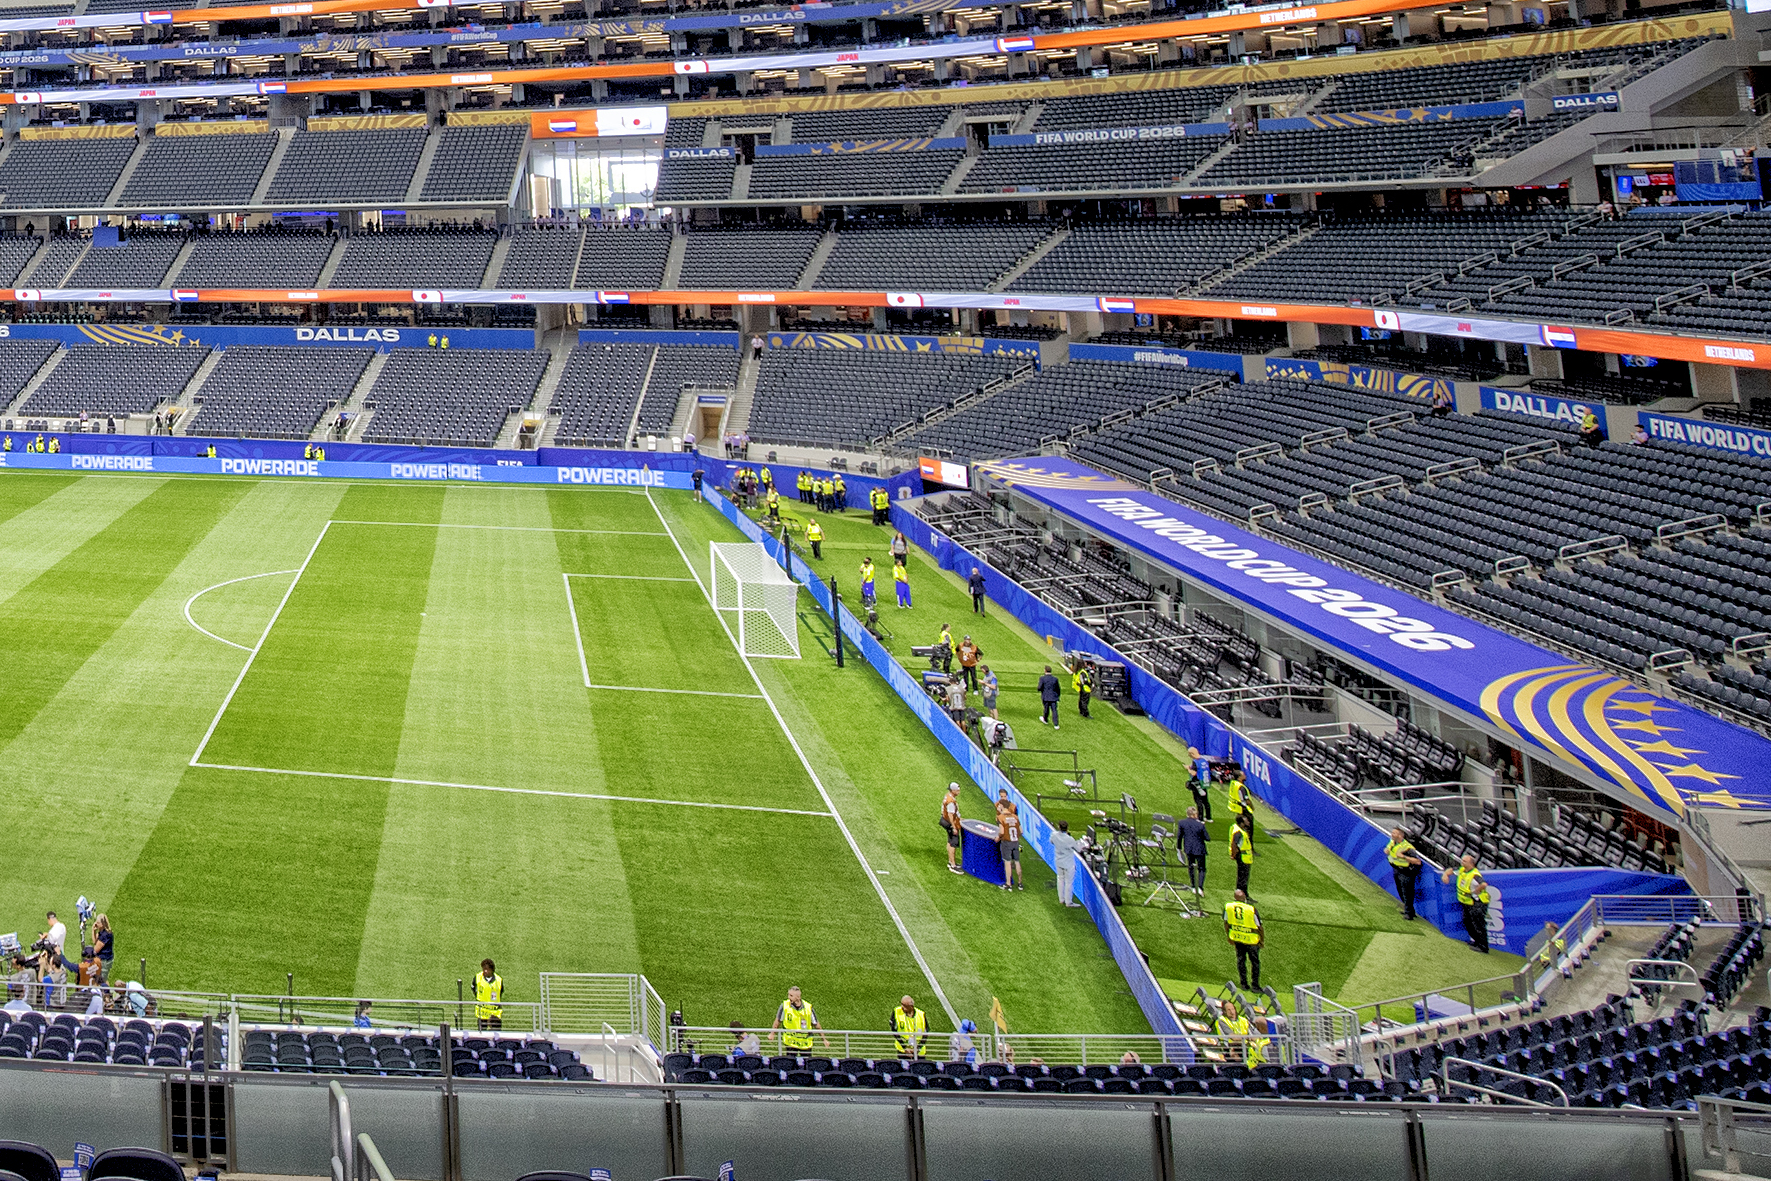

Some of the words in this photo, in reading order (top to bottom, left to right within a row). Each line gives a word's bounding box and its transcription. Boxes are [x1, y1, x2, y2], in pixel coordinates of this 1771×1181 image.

[739, 10, 806, 24] DALLAS
[1260, 8, 1317, 24] NETHERLANDS
[184, 45, 237, 56] DALLAS
[836, 53, 859, 62] JAPAN
[1554, 94, 1618, 108] DALLAS
[1035, 134, 1063, 143] FIFA
[1064, 131, 1109, 142] WORLD
[1111, 129, 1137, 140] CUP
[1138, 126, 1186, 138] 2026
[669, 149, 730, 158] DALLAS
[1003, 298, 1020, 306] JAPAN
[1241, 306, 1277, 317] NETHERLANDS
[296, 329, 400, 342] DALLAS
[1134, 350, 1188, 366] #FIFAWorldCup
[1704, 345, 1755, 362] NETHERLANDS
[1494, 391, 1586, 424] DALLAS
[1649, 417, 1688, 441] FIFA
[1686, 423, 1750, 452] WORLD
[71, 455, 154, 471] POWERADE
[221, 458, 320, 476] POWERADE
[391, 464, 482, 480] POWERADE
[1086, 498, 1164, 521] FIFA
[1133, 518, 1259, 561] WORLD
[1226, 559, 1328, 588] CUP
[1286, 588, 1476, 651] 2026
[888, 657, 933, 729] POWERADE
[1242, 746, 1272, 787] FIFA
